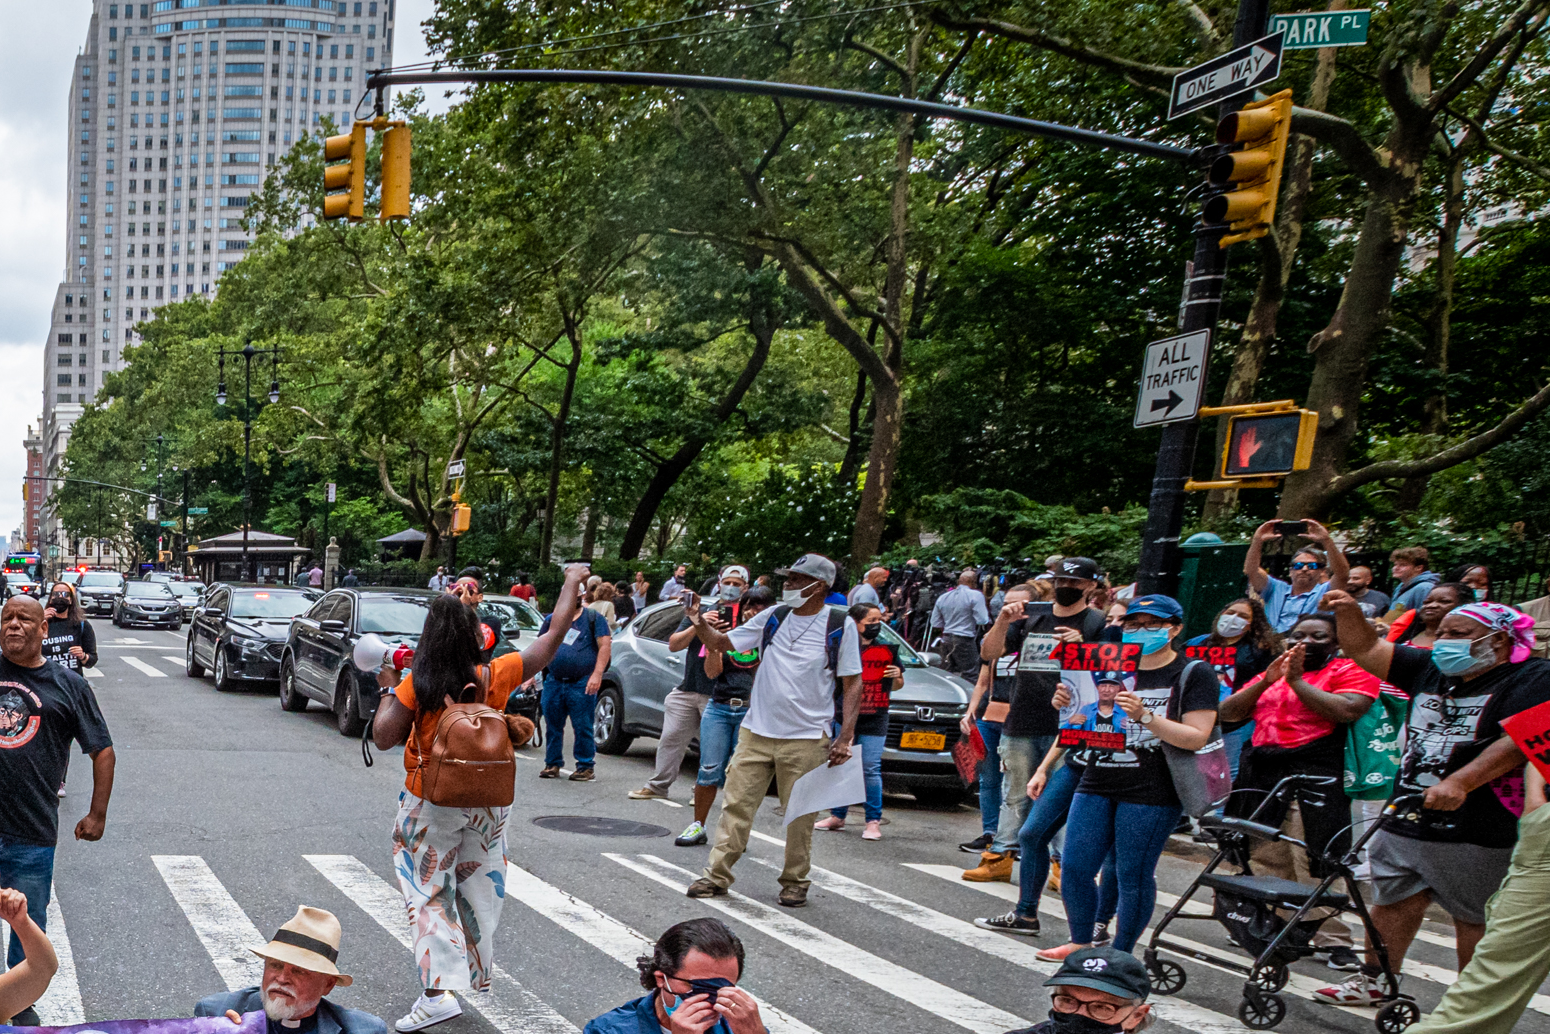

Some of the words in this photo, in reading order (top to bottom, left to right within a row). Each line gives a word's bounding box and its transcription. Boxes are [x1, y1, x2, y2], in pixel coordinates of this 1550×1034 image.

[1276, 17, 1333, 45] PARK
[1340, 15, 1362, 29] PL
[1186, 72, 1218, 99] ONE
[1230, 52, 1266, 82] WAY
[1158, 342, 1191, 368] ALL
[1146, 365, 1199, 391] TRAFFIC
[41, 635, 74, 645] OUSING
[52, 645, 61, 653] IS
[1064, 643, 1140, 661] STOP
[1185, 646, 1237, 658] STOP
[1063, 658, 1137, 672] FAILING
